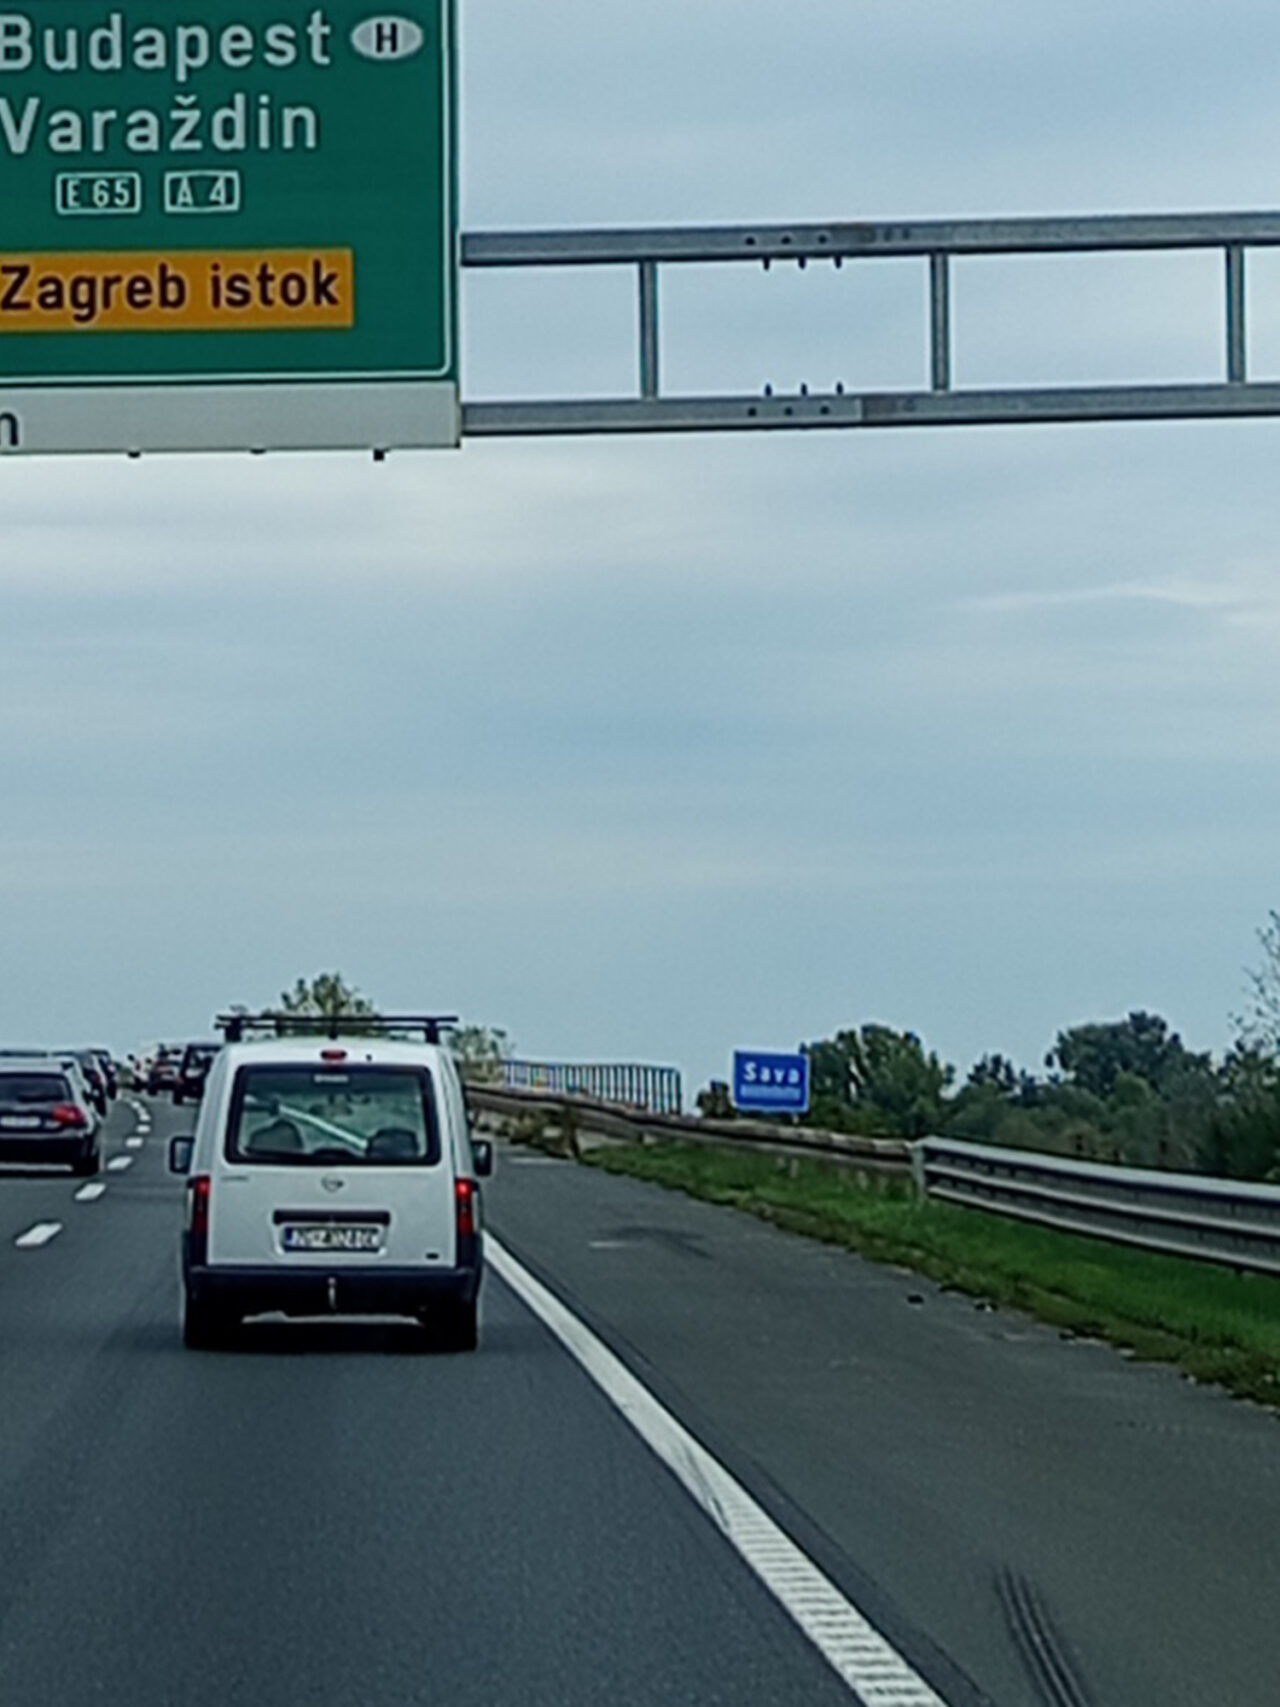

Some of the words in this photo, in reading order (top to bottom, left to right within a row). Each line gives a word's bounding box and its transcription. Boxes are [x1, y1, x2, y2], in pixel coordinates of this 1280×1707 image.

[376, 23, 398, 53] H
[0, 263, 185, 322] Zagreb
[212, 259, 339, 308] istok
[743, 1060, 800, 1084] Sava
